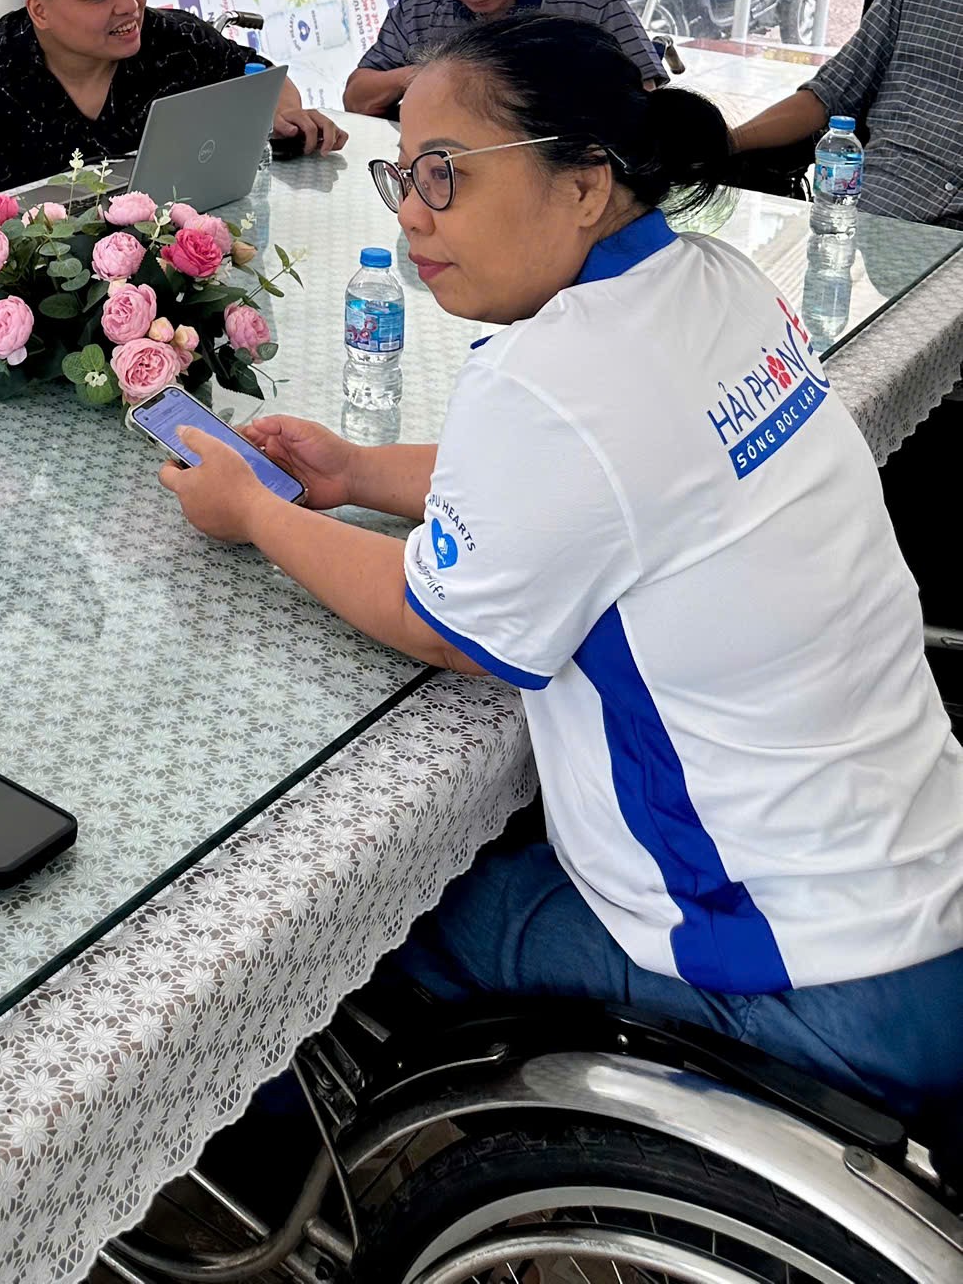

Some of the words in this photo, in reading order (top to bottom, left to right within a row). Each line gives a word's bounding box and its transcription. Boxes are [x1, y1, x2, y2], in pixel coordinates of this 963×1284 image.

[706, 381, 757, 445] HẢI
[737, 429, 776, 469] SỐNG
[775, 406, 799, 434] ĐỘC
[798, 386, 816, 410] LẬP
[442, 500, 476, 551] HEARTS
